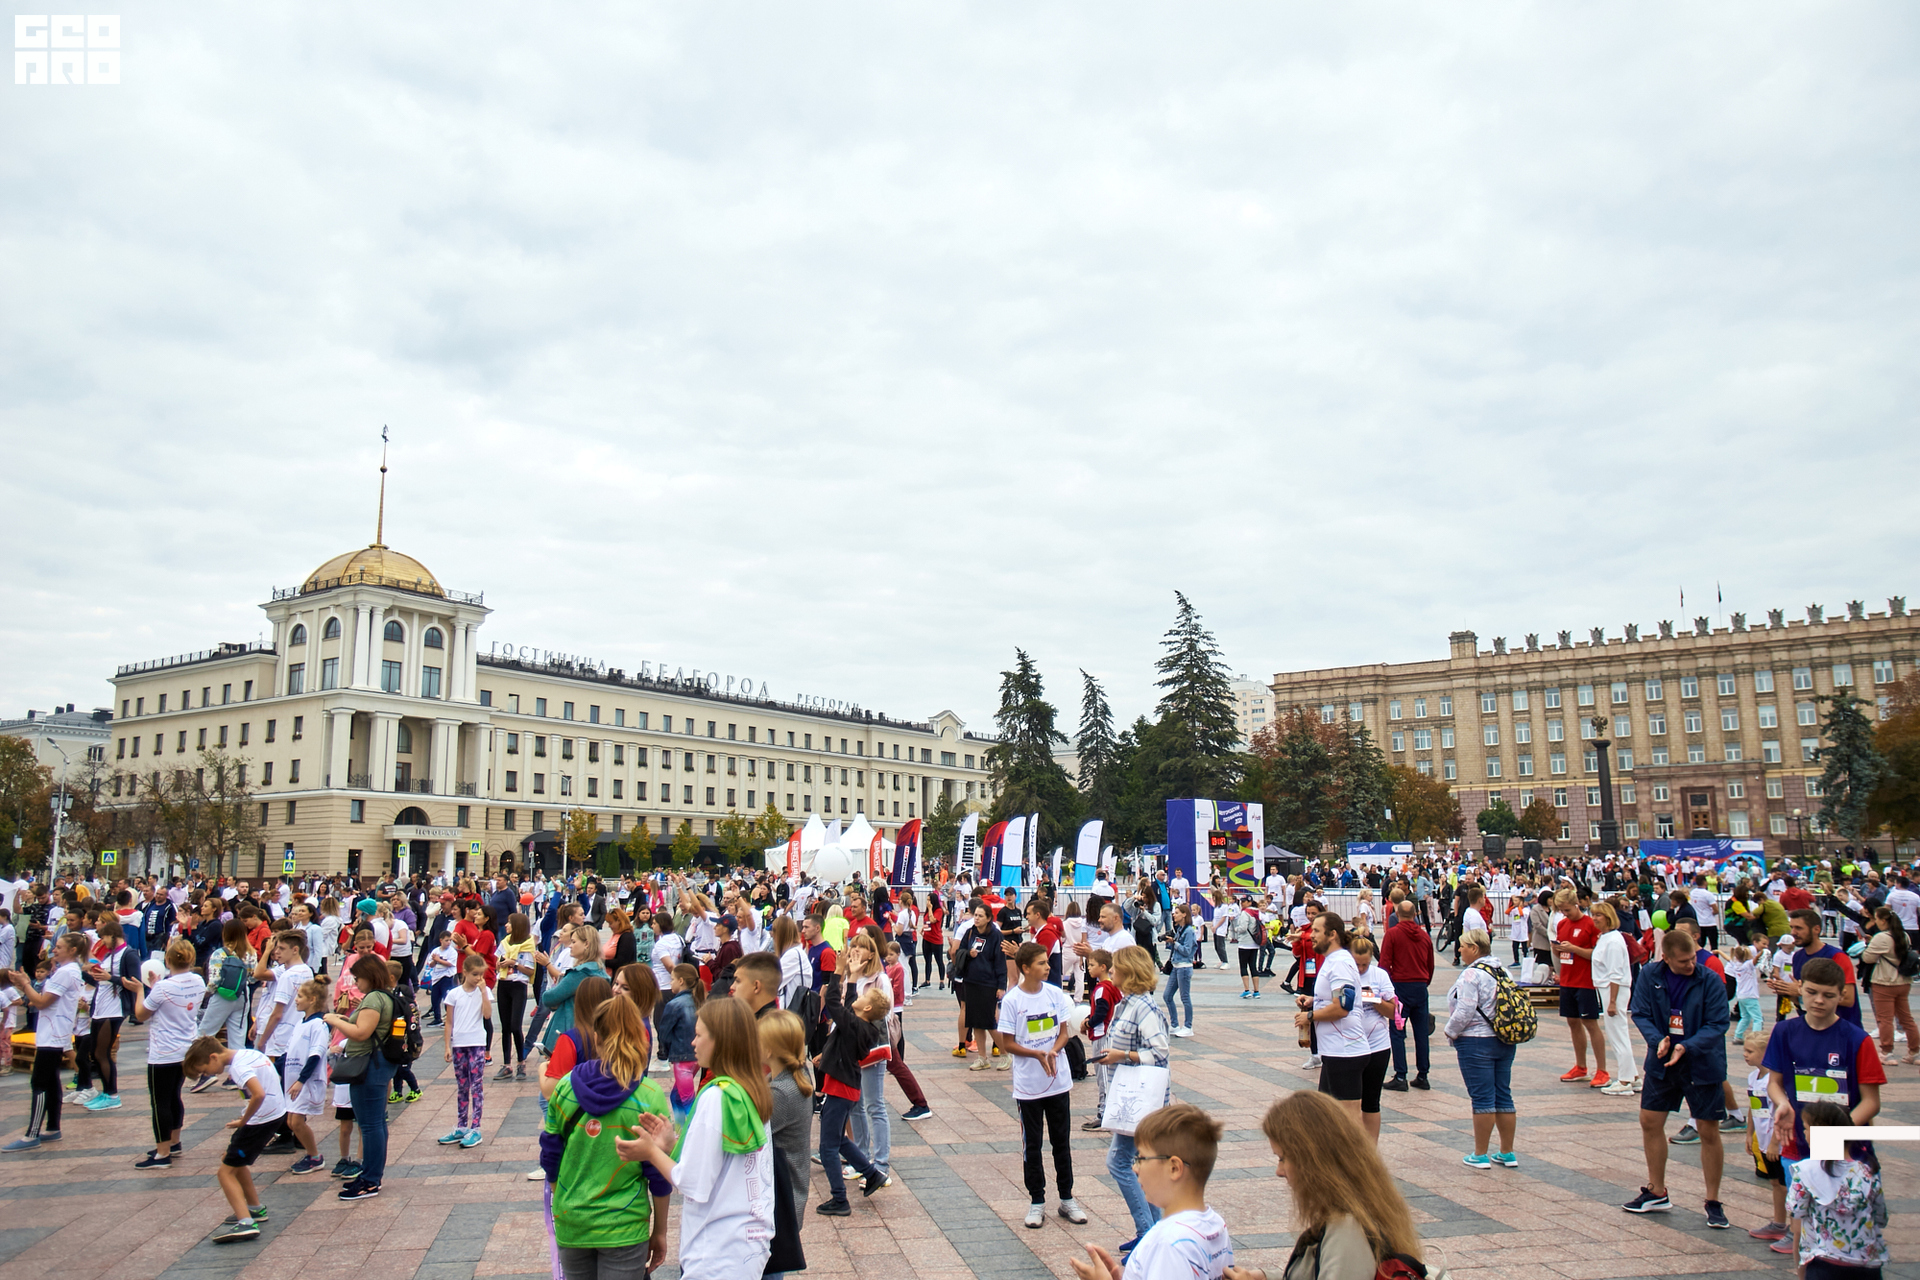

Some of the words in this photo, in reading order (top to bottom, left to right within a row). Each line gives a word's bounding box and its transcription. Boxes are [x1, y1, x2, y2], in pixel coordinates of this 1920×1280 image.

[491, 641, 606, 671] ГОСТИНИЦА
[641, 660, 770, 698] БЕЛГОРОД
[797, 693, 859, 712] РЕСТОРАН
[1038, 1020, 1044, 1031] 1
[1810, 1077, 1818, 1092] 1
